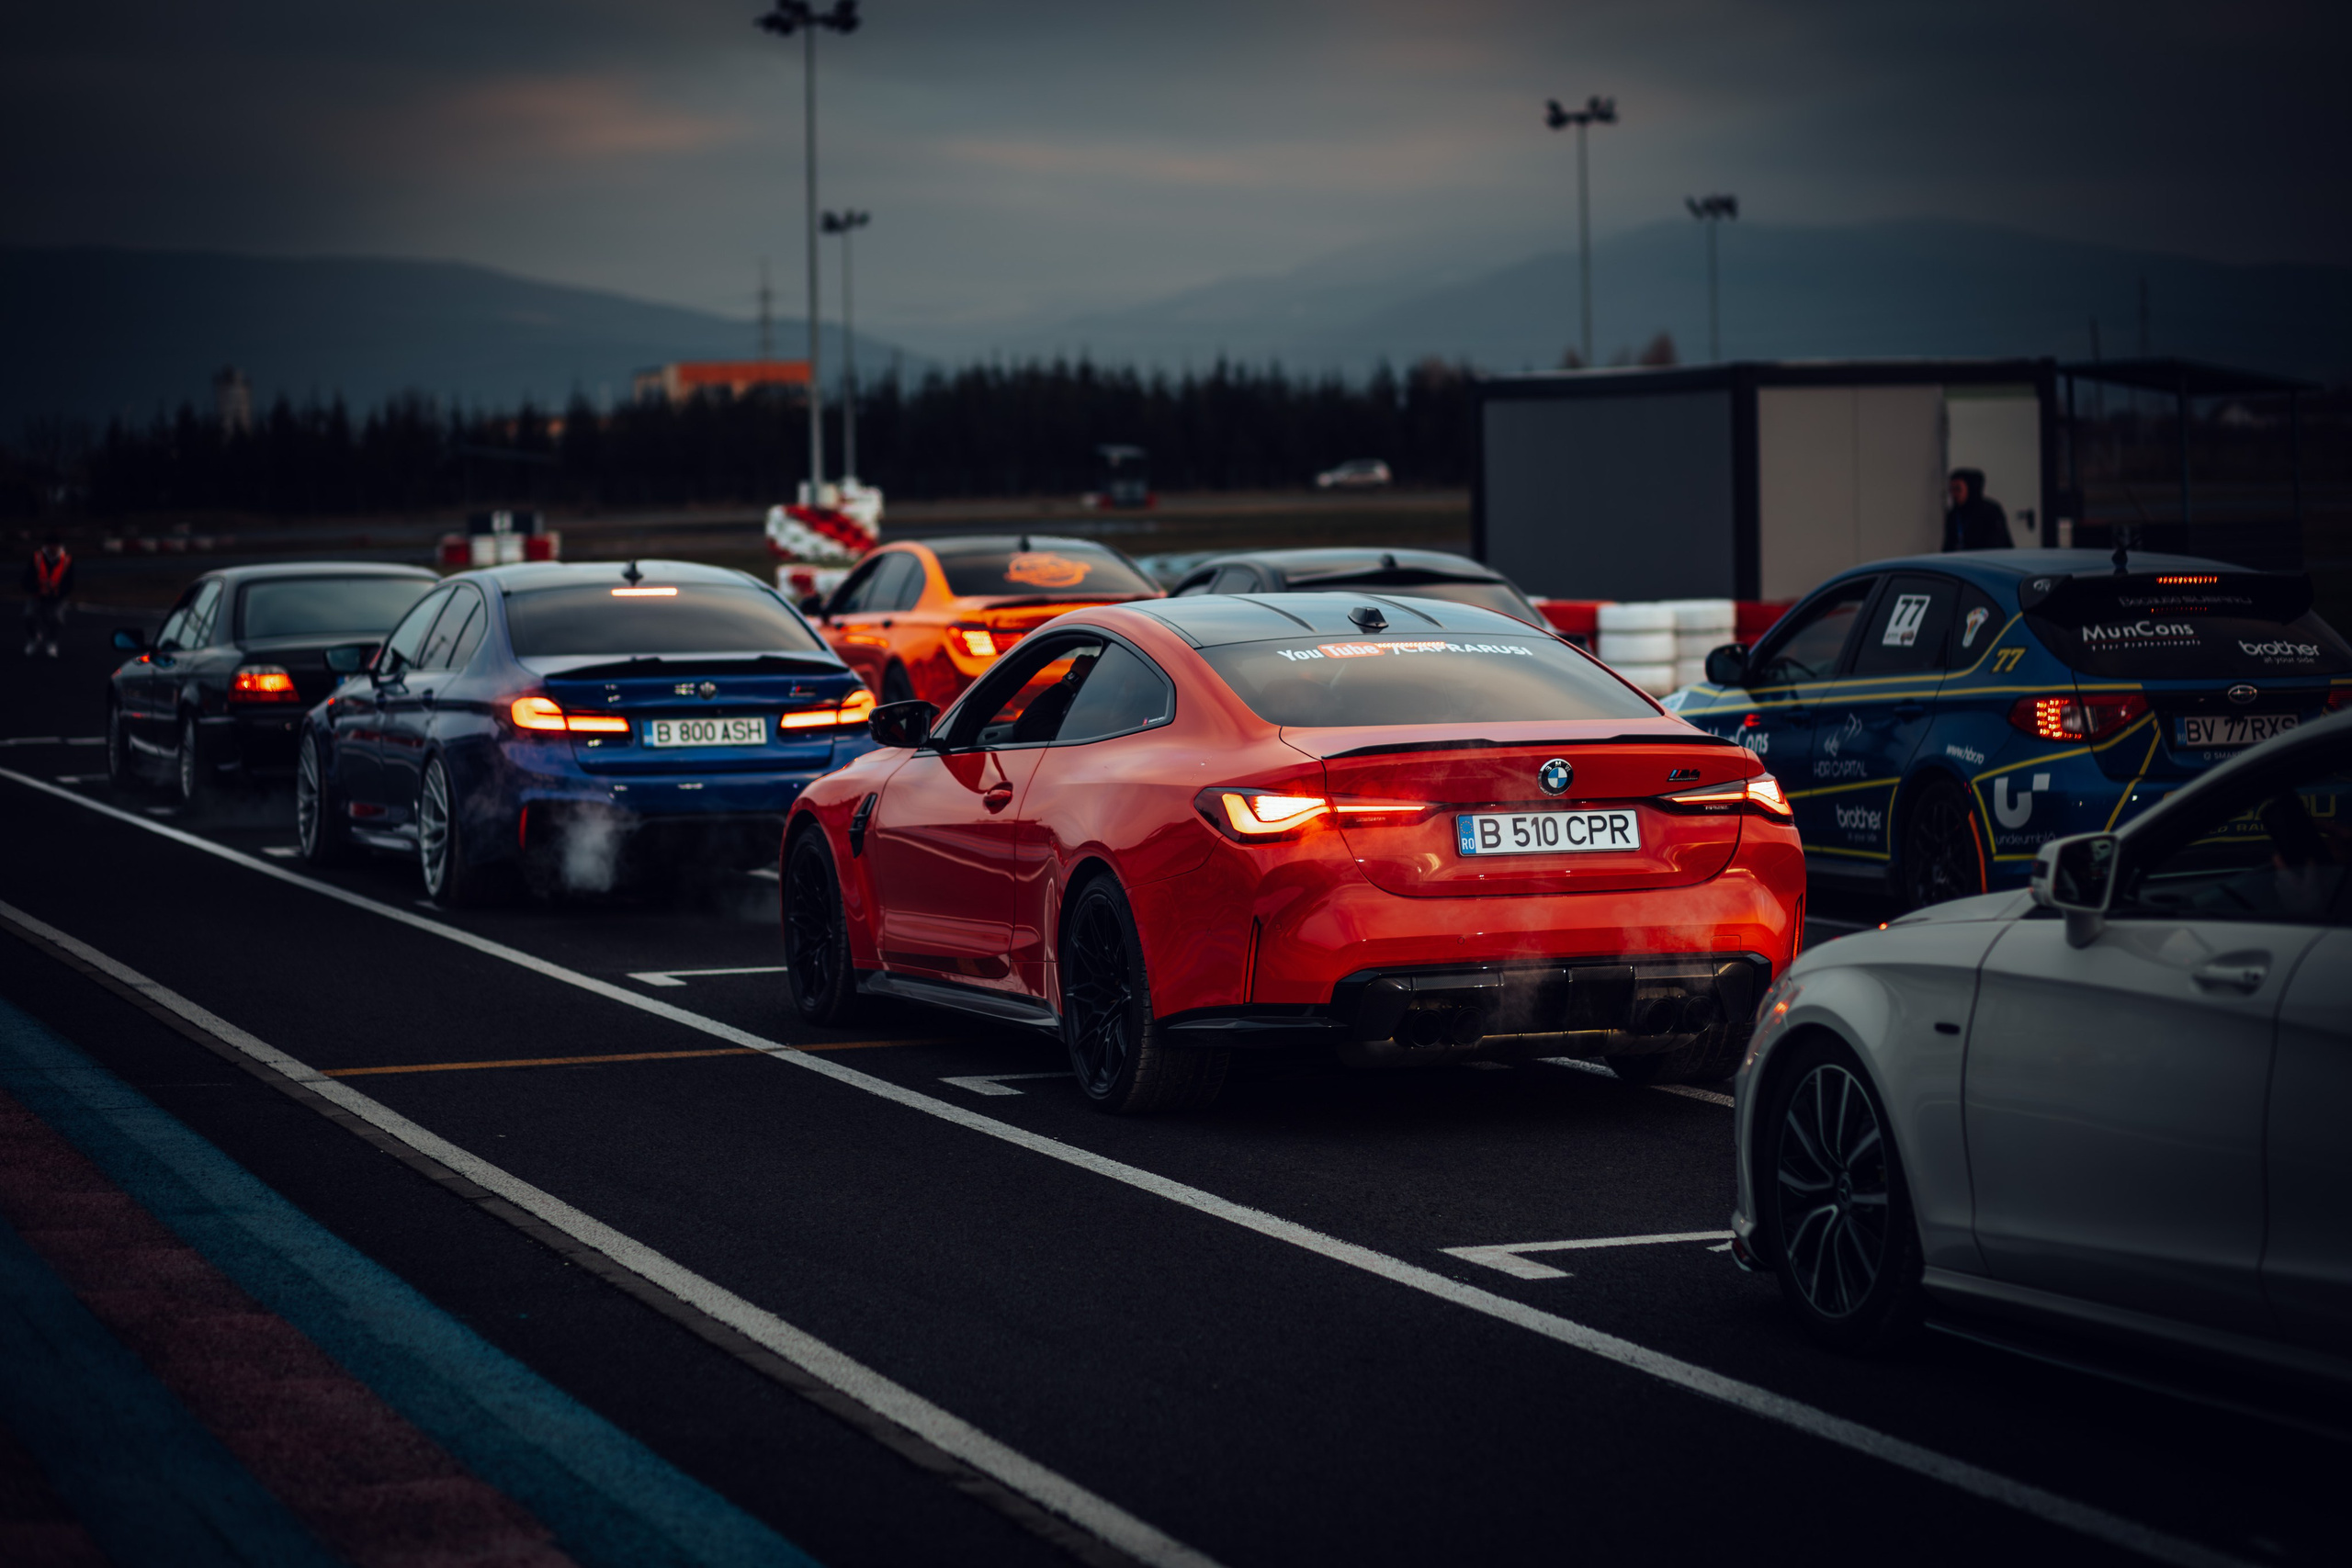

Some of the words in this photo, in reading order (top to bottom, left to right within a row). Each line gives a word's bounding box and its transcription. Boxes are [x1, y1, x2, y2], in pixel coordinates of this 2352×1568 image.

[1894, 599, 1927, 626] 77
[2082, 621, 2195, 643] MunCons
[2238, 640, 2320, 657] brother
[1991, 649, 2027, 673] 77
[657, 723, 671, 742] B
[679, 722, 716, 741] 800
[721, 720, 762, 740] ASH
[2186, 720, 2215, 742] BV
[1836, 803, 1882, 829] brother
[1479, 818, 1502, 849] B
[1512, 816, 1559, 846] 510
[1566, 814, 1631, 845] CPR
[1462, 838, 1475, 851] RO
